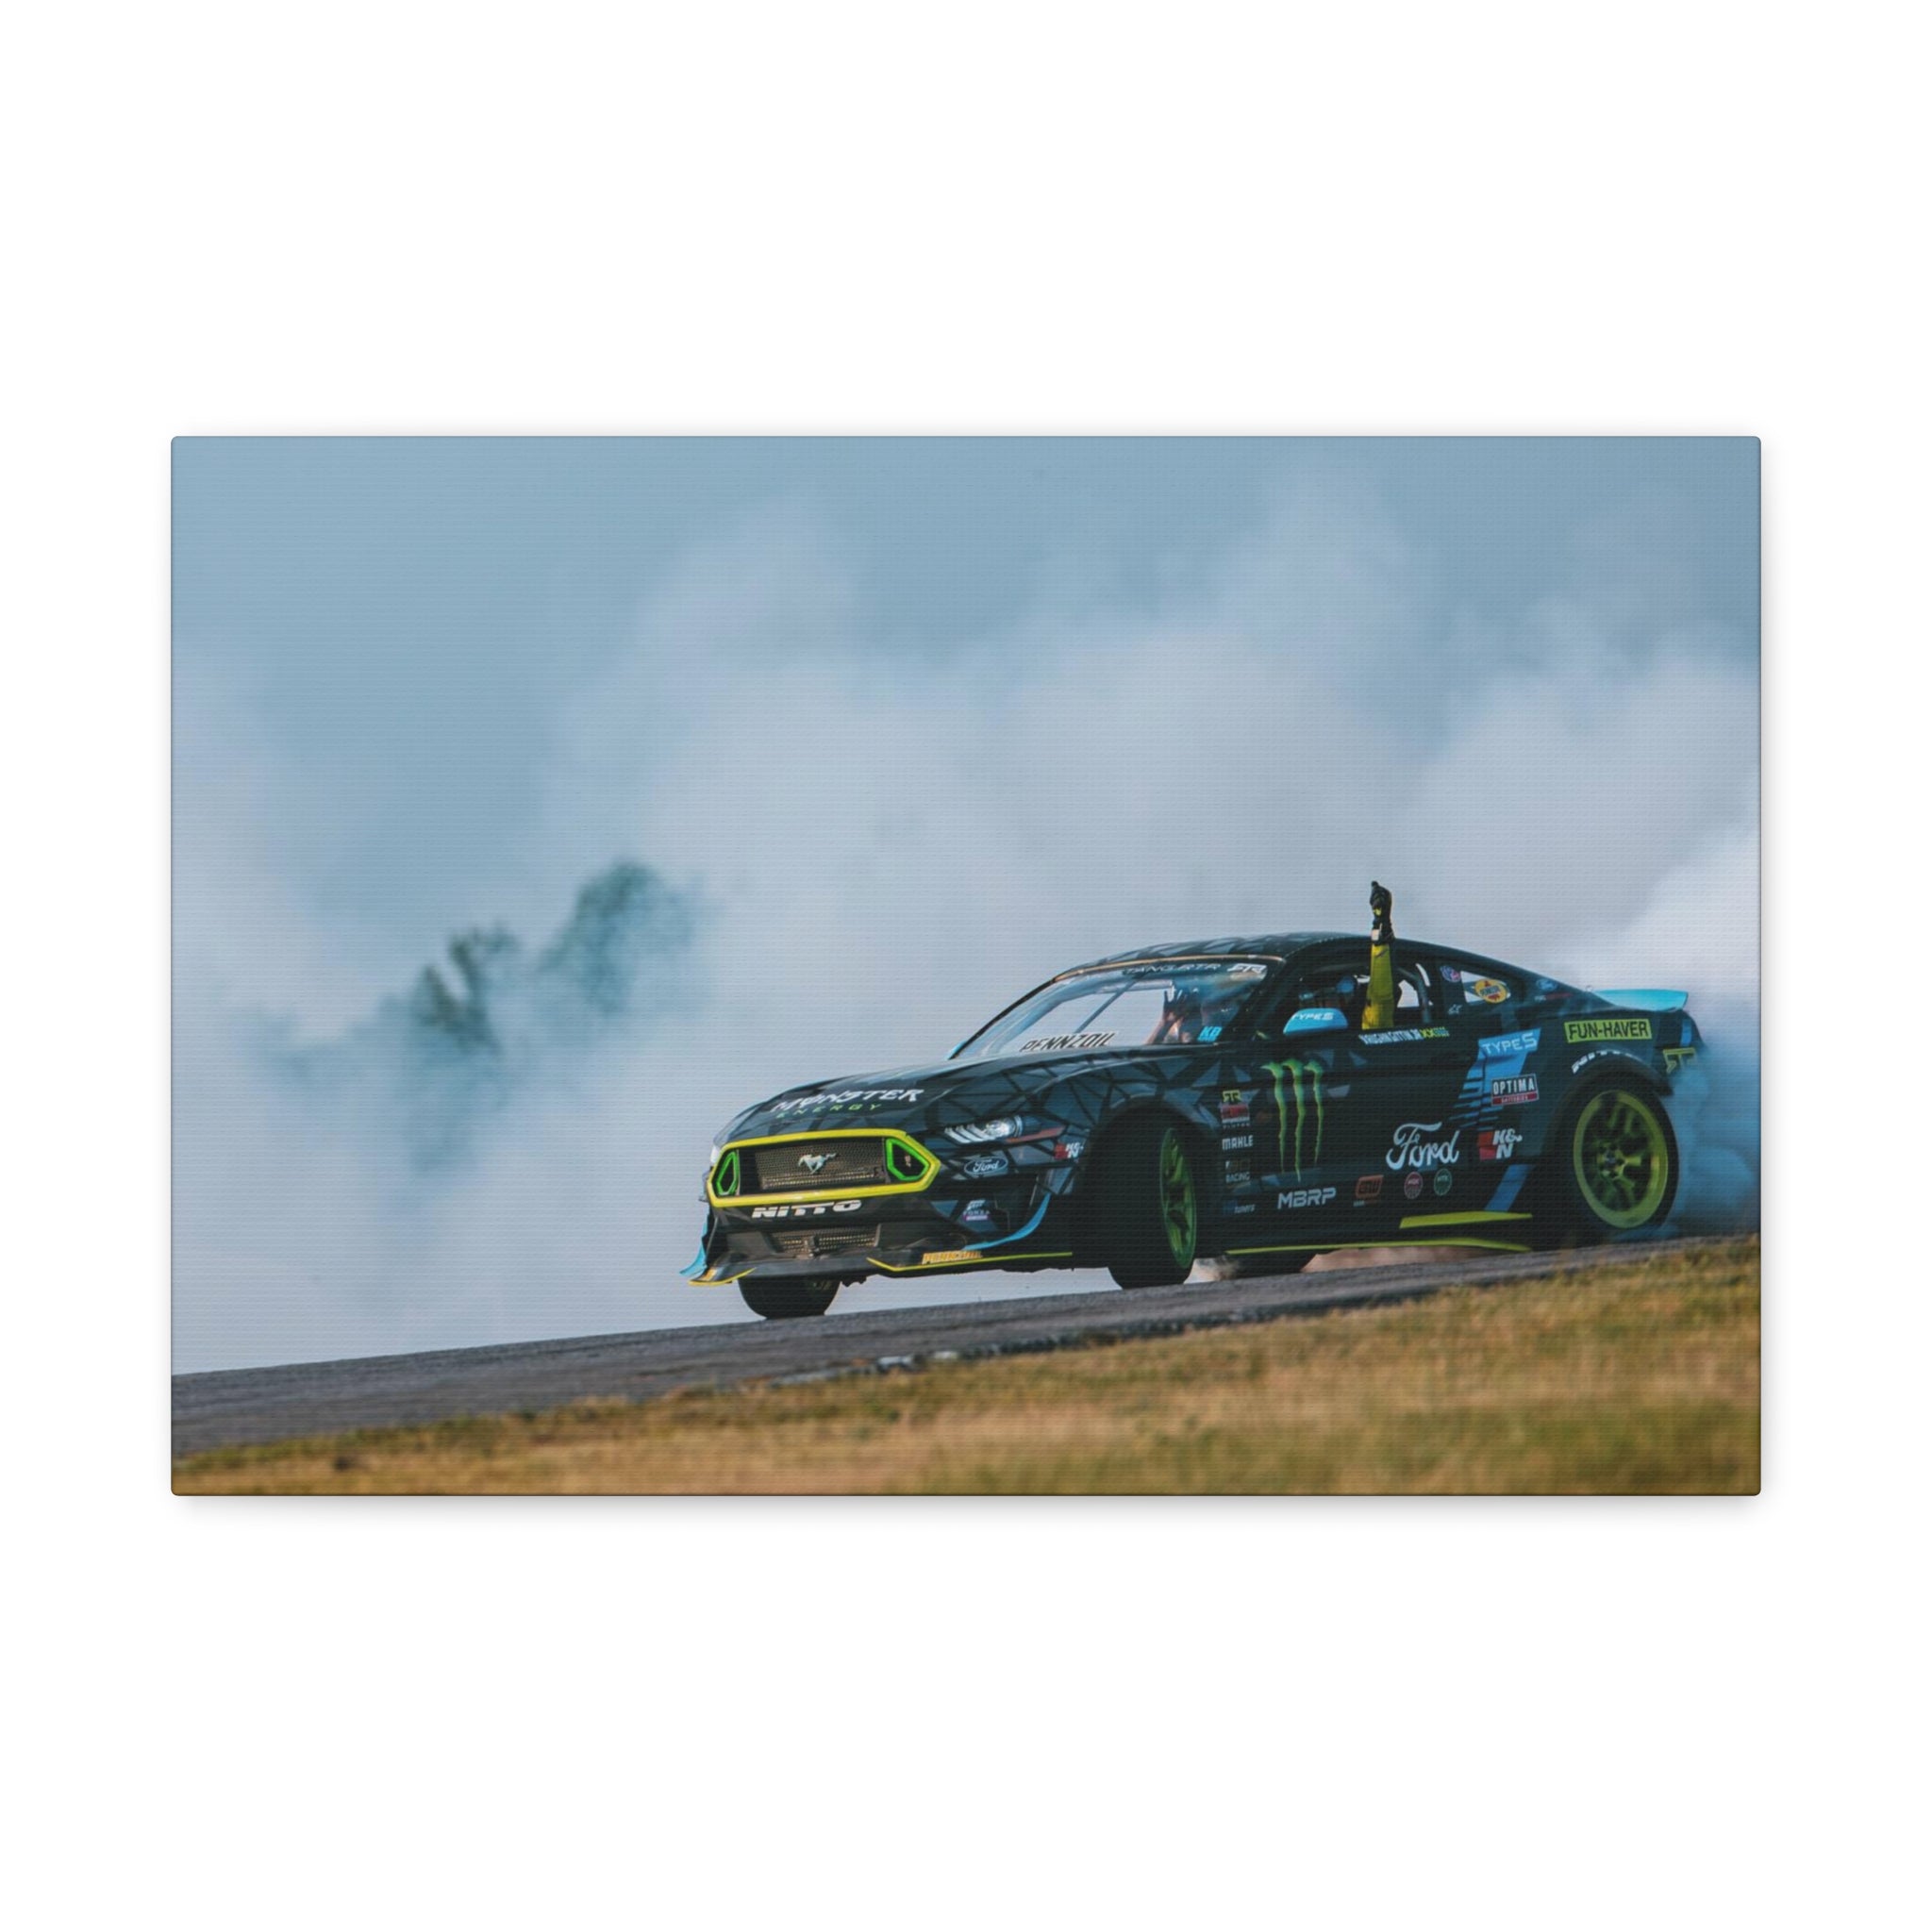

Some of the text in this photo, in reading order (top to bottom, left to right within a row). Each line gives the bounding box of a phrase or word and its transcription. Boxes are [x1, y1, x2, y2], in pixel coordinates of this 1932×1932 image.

[1568, 1021, 1649, 1041] FUN-HAVER
[1019, 1033, 1117, 1053] PENNZOIL
[1492, 1077, 1535, 1095] OPTIMA
[770, 1089, 924, 1113] MONSTER
[776, 1103, 882, 1119] ENERGY
[1222, 1135, 1254, 1151] MAHLE
[1385, 1122, 1459, 1171] Ford
[972, 1160, 1000, 1173] Ford
[1276, 1187, 1337, 1210] MBRP
[751, 1200, 862, 1219] NITTO
